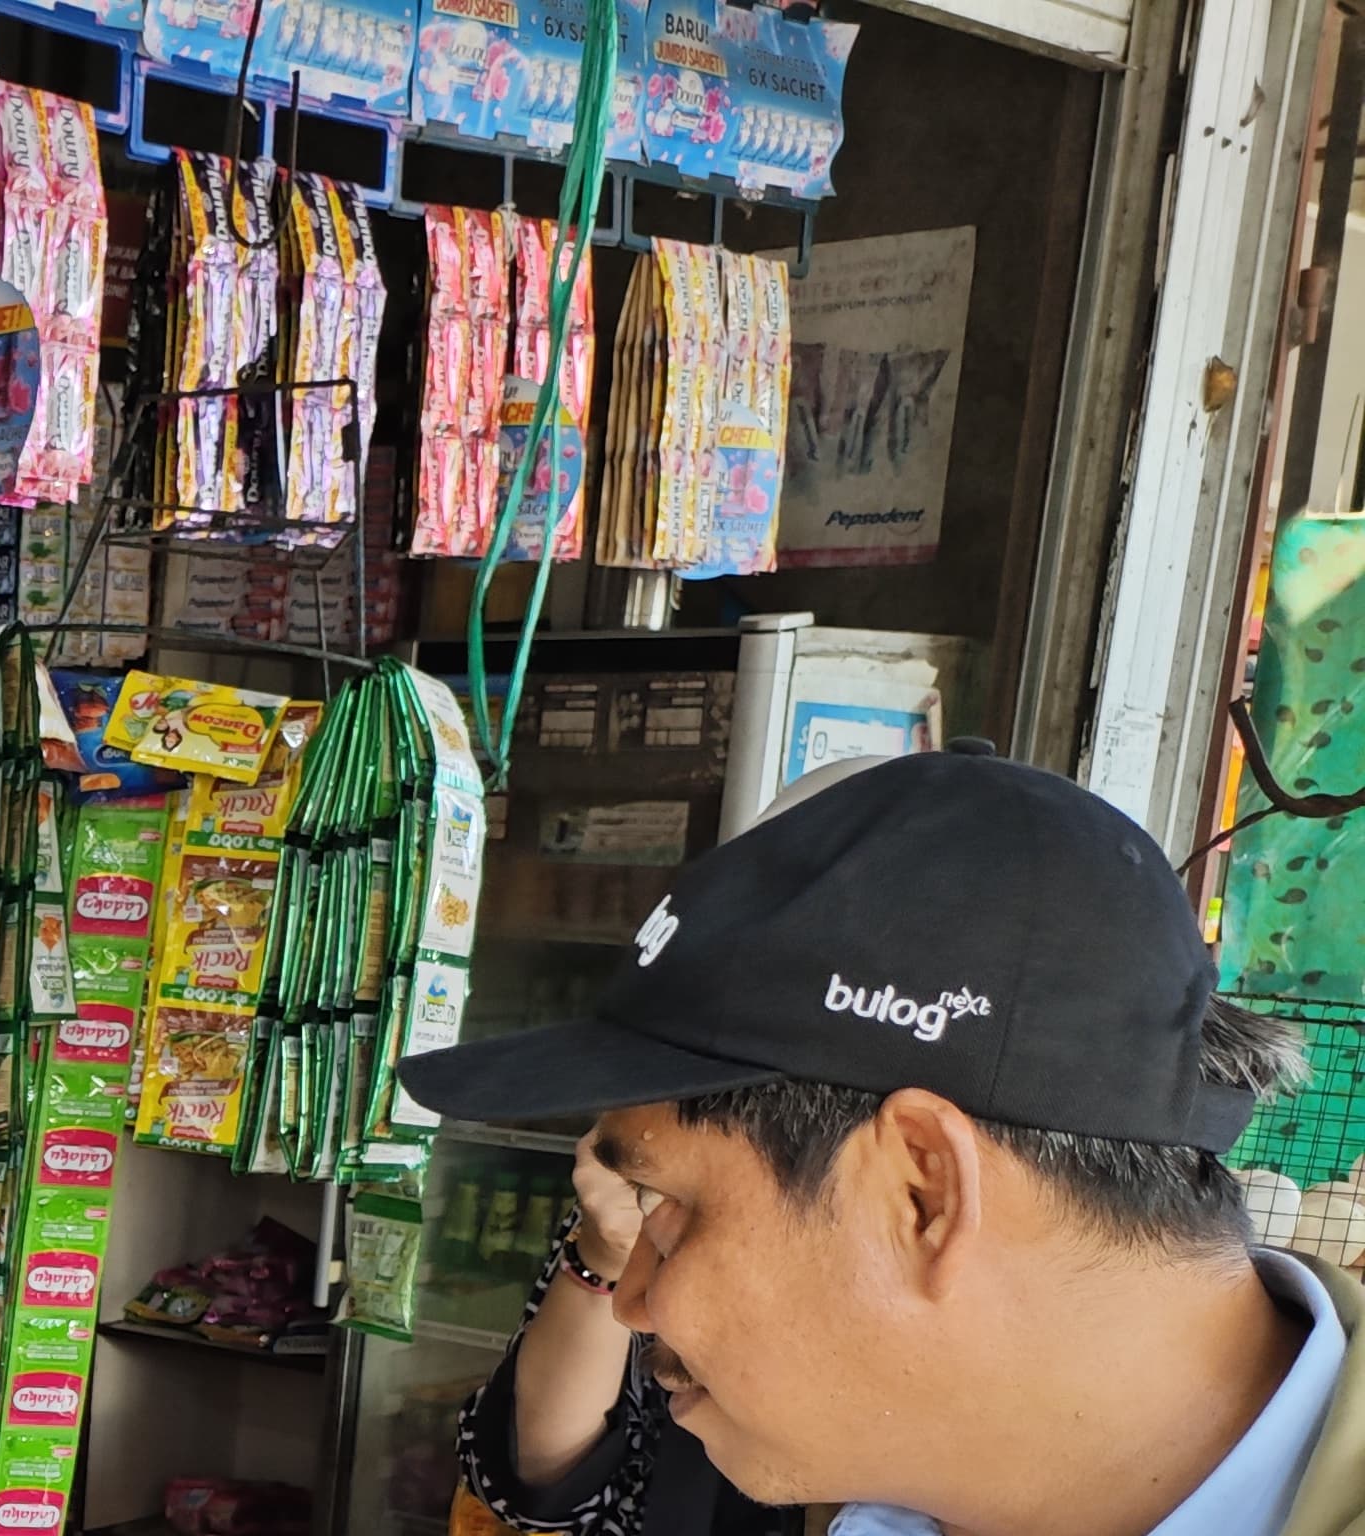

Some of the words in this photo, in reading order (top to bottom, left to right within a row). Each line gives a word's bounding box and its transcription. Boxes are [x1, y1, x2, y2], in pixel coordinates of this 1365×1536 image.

[545, 16, 565, 39] 6X
[665, 13, 710, 44] BARU!
[658, 40, 687, 64] JUMBO
[748, 67, 768, 89] 6X
[771, 75, 826, 102] SACHET
[10, 94, 30, 170] Downy
[60, 105, 80, 180] Downy
[825, 506, 925, 531] Pepsodent
[191, 713, 260, 739] Dancow
[219, 795, 277, 817] Racik
[83, 897, 144, 920] Ladaku
[192, 950, 253, 972] Racik
[824, 973, 947, 1042] bulog
[938, 986, 991, 1019] next
[65, 1023, 125, 1046] Ladaku
[50, 1146, 111, 1169] Ladaku
[34, 1269, 93, 1292] Ladaku
[18, 1388, 76, 1411] Ladaku
[1, 1506, 60, 1530] Ladaku
